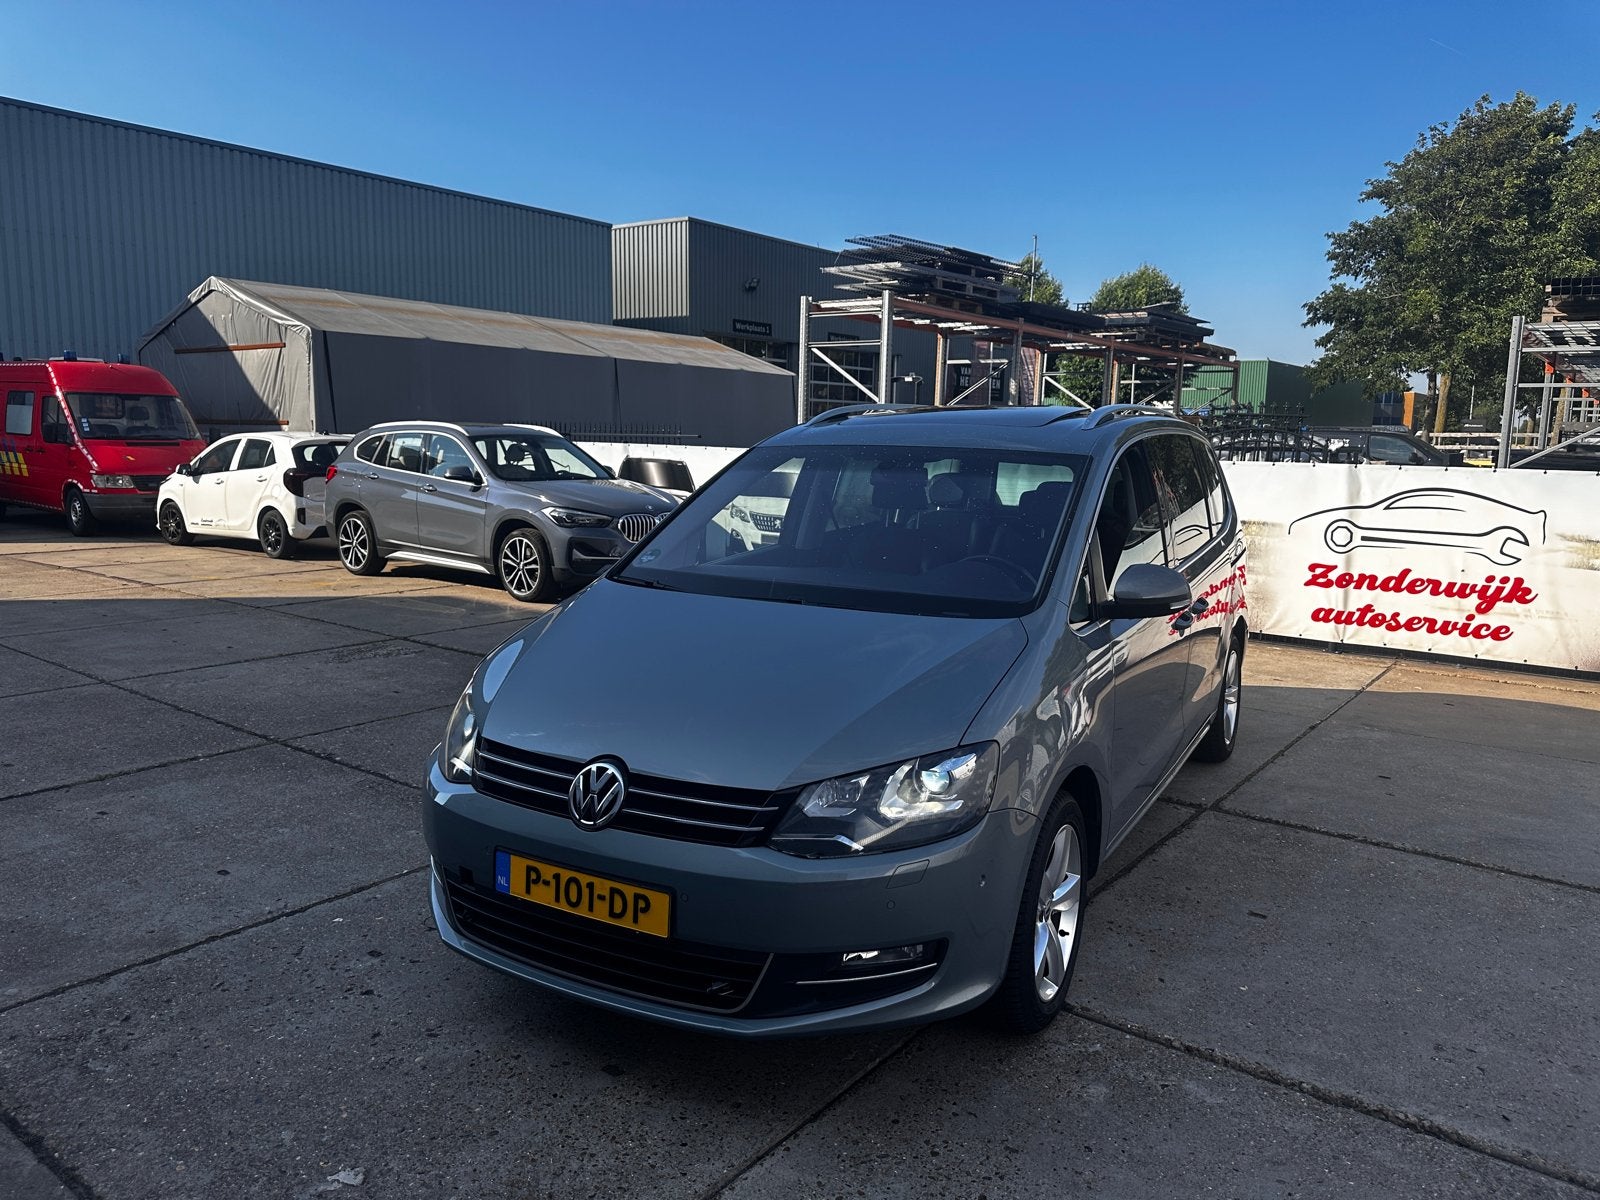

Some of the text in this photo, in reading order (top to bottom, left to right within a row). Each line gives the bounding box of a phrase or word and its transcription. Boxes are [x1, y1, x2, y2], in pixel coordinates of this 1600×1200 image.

[1303, 562, 1539, 615] Zonderwijk
[1310, 603, 1514, 641] autoservice
[497, 863, 651, 925] NL P-101-DP
